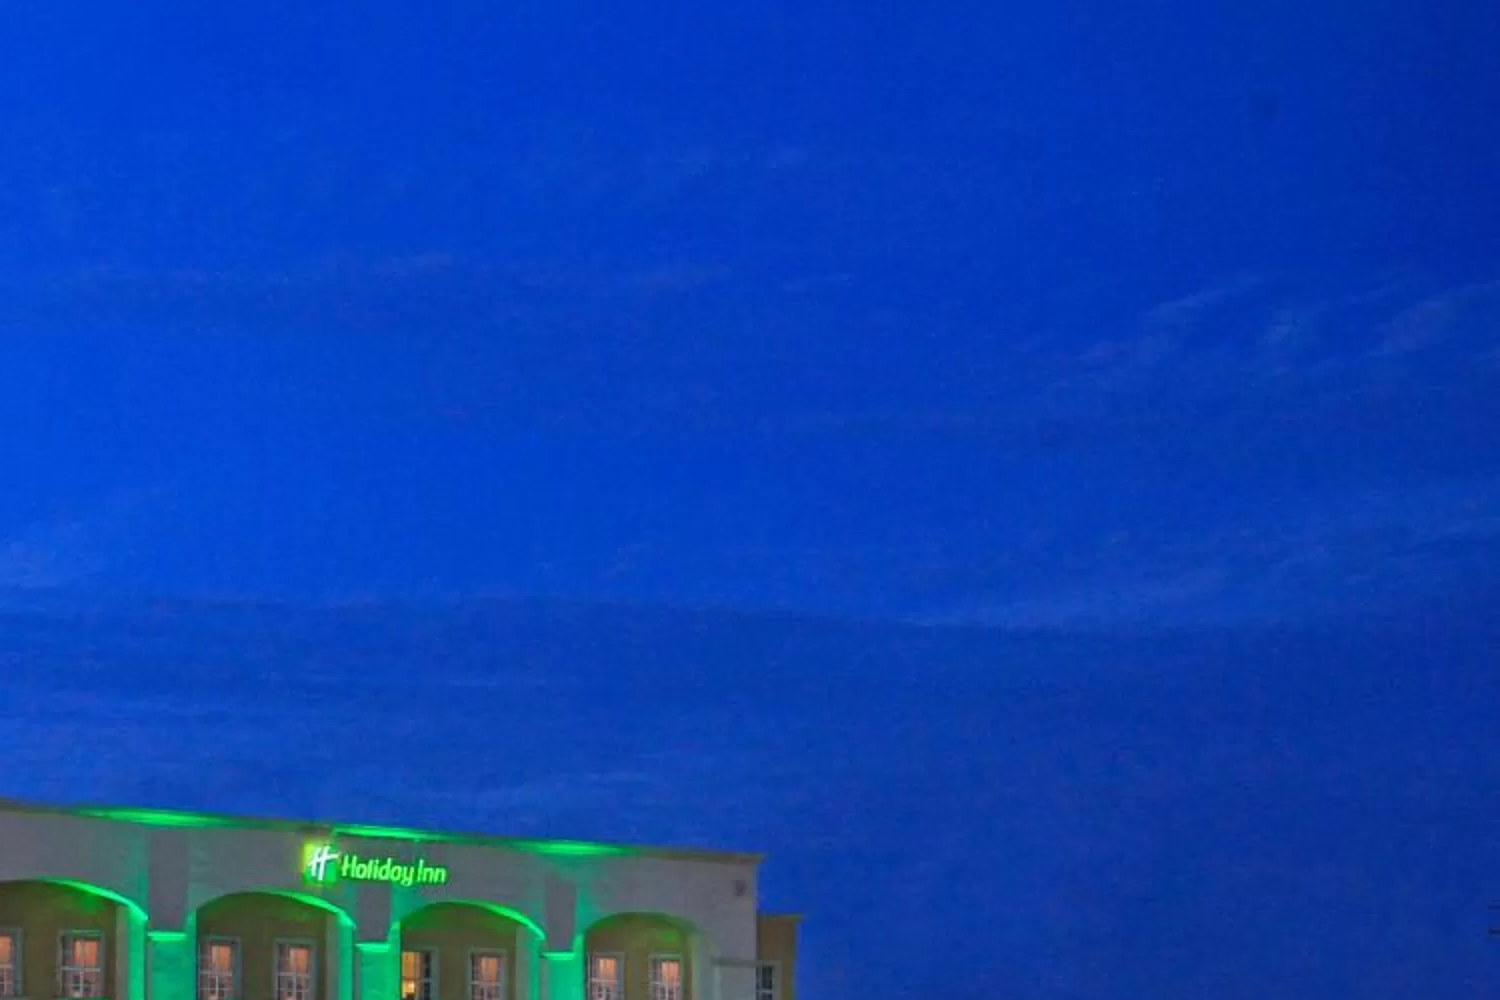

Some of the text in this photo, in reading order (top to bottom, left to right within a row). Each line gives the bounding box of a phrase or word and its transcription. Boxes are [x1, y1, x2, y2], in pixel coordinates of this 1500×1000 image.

[309, 845, 340, 881] H
[341, 855, 446, 887] Holiday Inn
